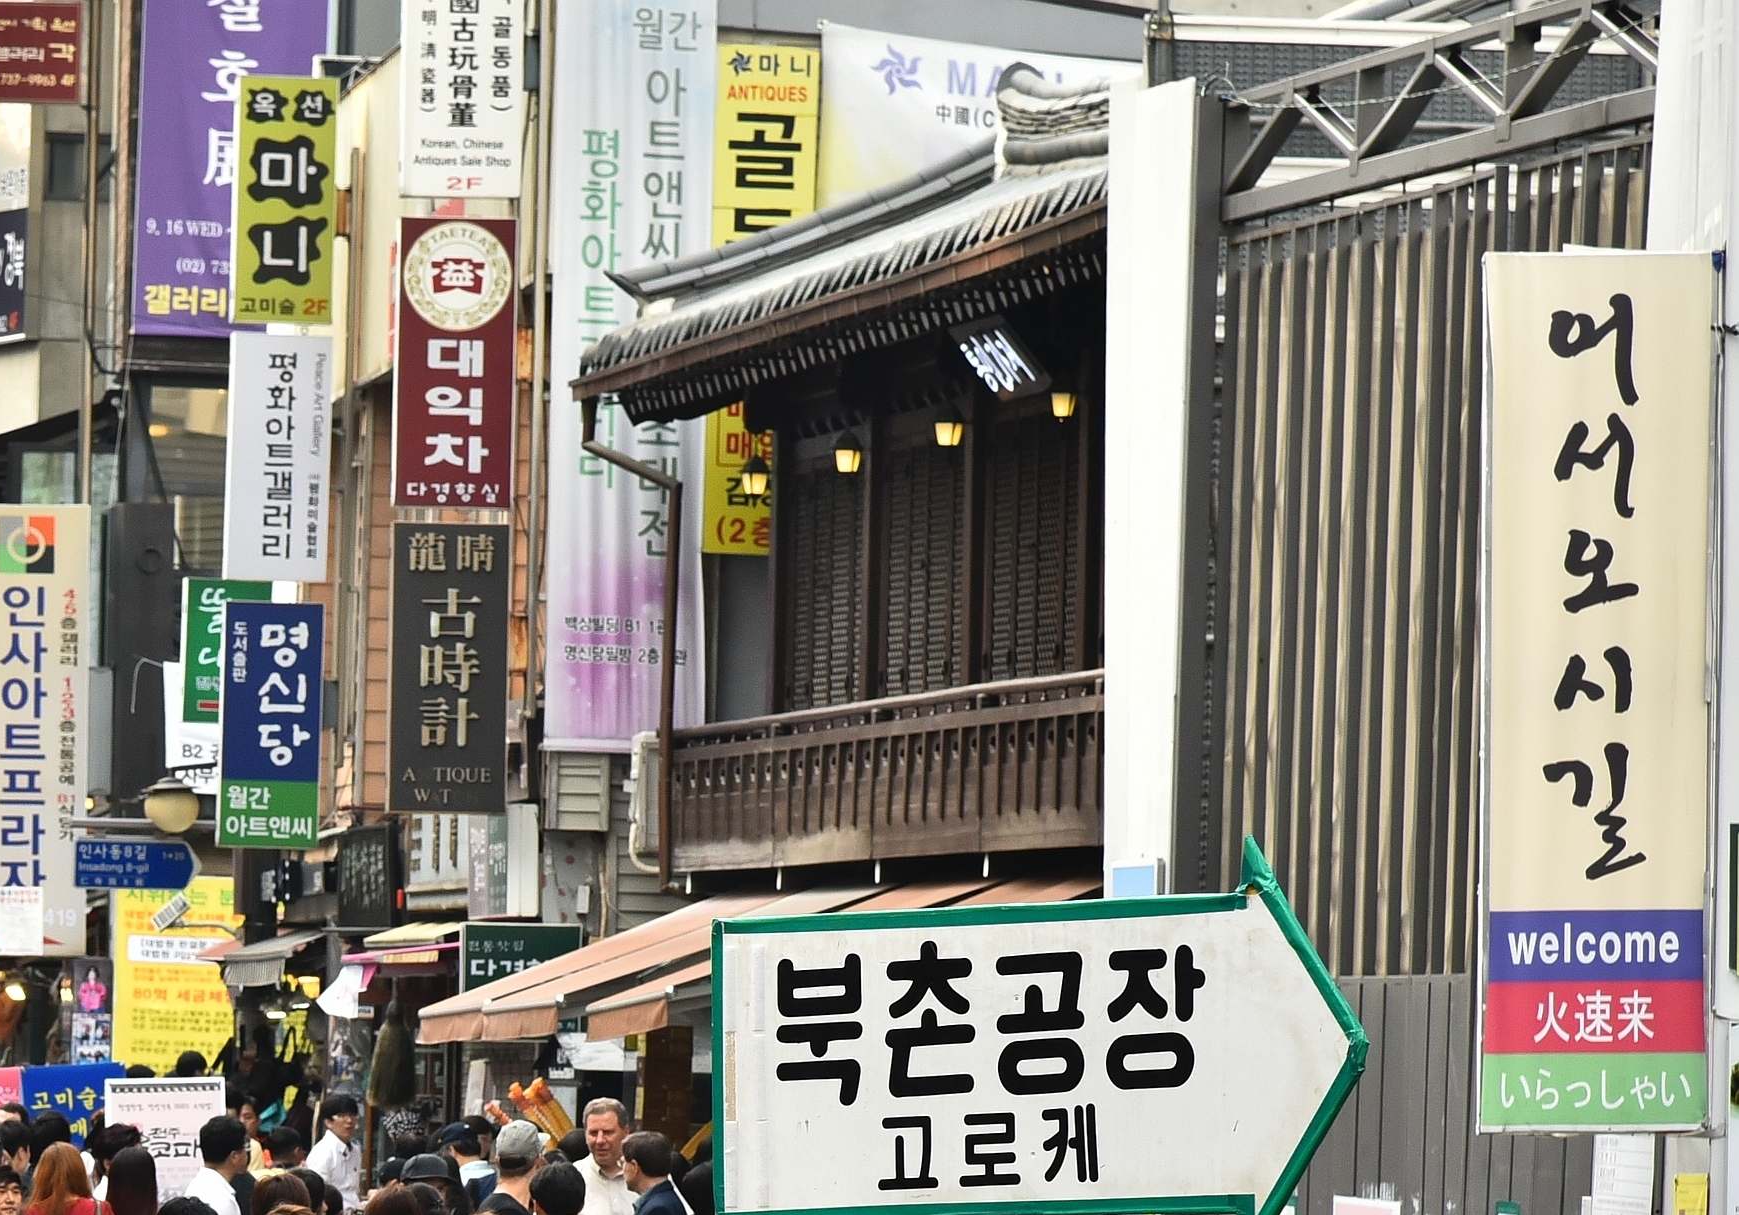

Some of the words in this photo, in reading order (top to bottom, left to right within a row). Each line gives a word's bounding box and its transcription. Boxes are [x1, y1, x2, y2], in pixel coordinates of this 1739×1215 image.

[633, 8, 702, 51] 월간
[759, 54, 811, 77] 마니
[253, 92, 324, 119] 옥션
[727, 85, 808, 102] ANTIQUES
[642, 67, 687, 259] 아트앤씨
[447, 177, 484, 190] 2F
[261, 147, 318, 273] 마니
[187, 220, 223, 238] WED
[176, 258, 206, 274] (02)
[144, 284, 228, 316] 갤러리
[239, 298, 296, 315] 고미술
[303, 298, 327, 314] 2F
[424, 338, 490, 474] 대익차
[262, 352, 298, 559] 평화아트갤러리
[406, 482, 500, 503] 다경향실
[232, 622, 249, 682] 도서출판
[419, 587, 482, 747] 古時計
[258, 621, 311, 767] 명신당
[0, 586, 48, 887] 인사아트프라자
[182, 744, 203, 759] B2
[226, 785, 271, 810] 월간
[225, 816, 313, 839] 아트앤씨
[78, 844, 148, 859] 인사동8길
[1507, 922, 1680, 965] welcome
[776, 941, 1206, 1107] 북촌공장
[1533, 988, 1655, 1044] 火速来
[31, 1087, 104, 1111] 고미술
[1501, 1069, 1691, 1110] いらっしゃい
[877, 1103, 1100, 1191] 고로케
